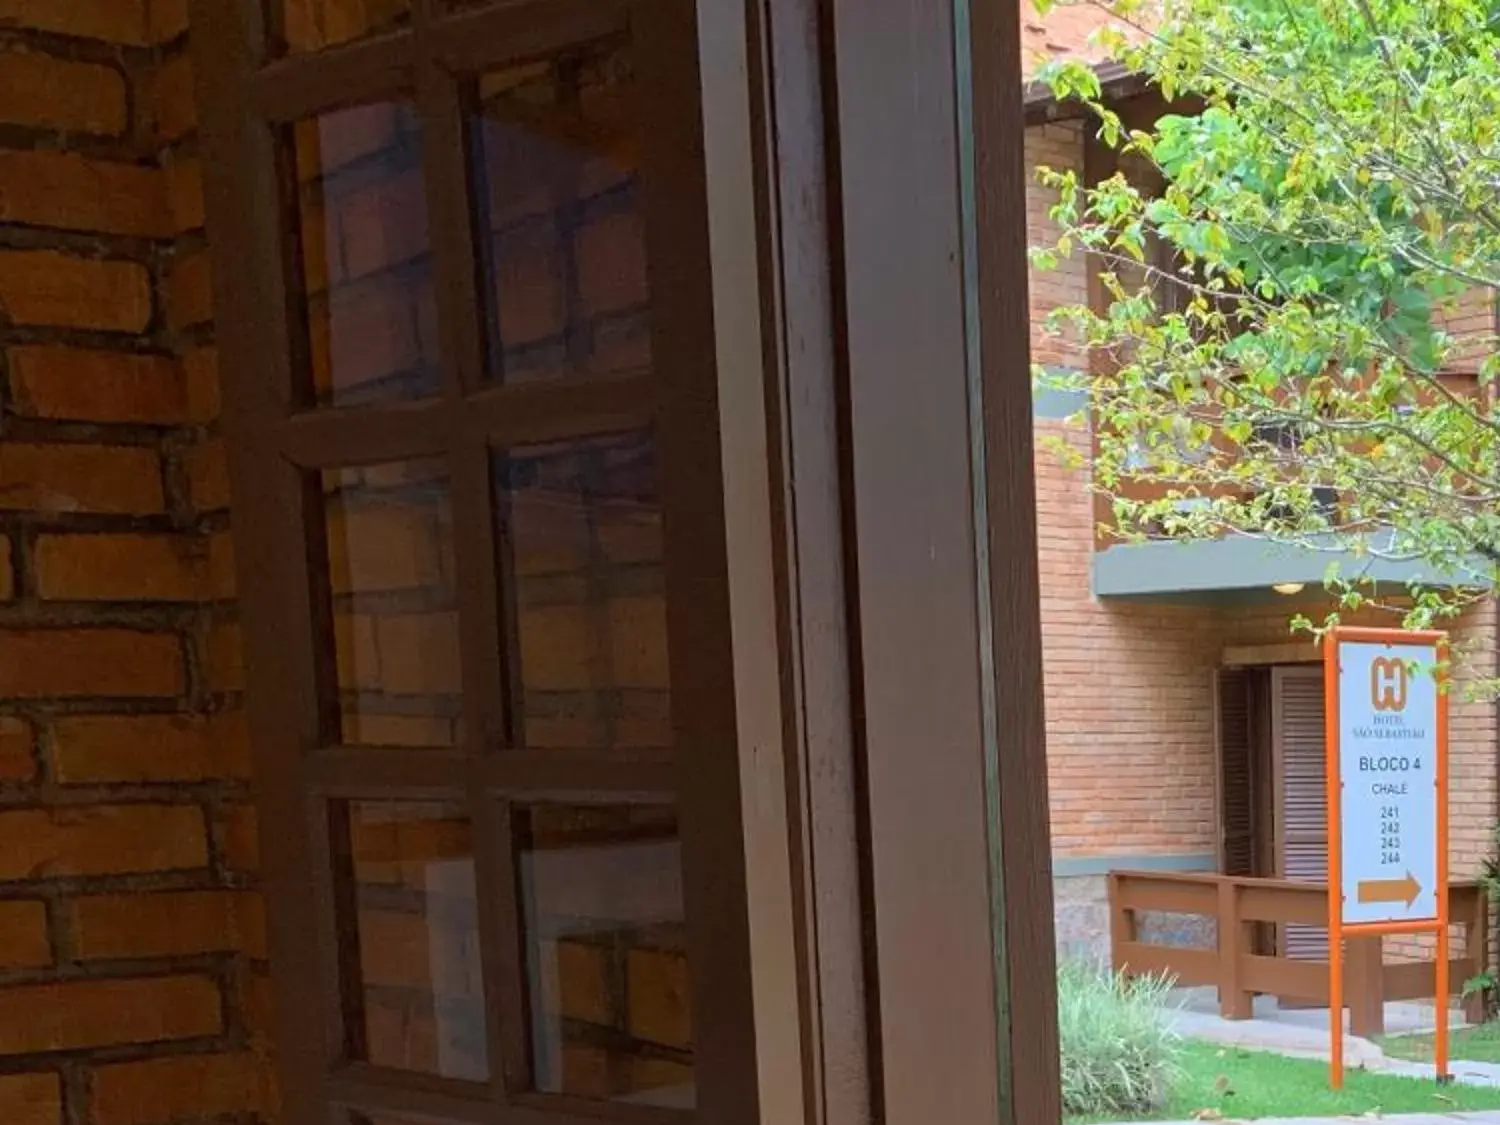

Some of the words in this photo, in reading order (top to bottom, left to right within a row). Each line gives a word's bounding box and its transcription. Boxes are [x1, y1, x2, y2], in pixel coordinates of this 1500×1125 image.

[1359, 756, 1409, 771] BLOCO
[1413, 757, 1421, 769] 4
[1380, 806, 1399, 818] 241
[1381, 821, 1400, 834] 242
[1381, 837, 1400, 849] 243
[1381, 852, 1400, 865] 244
